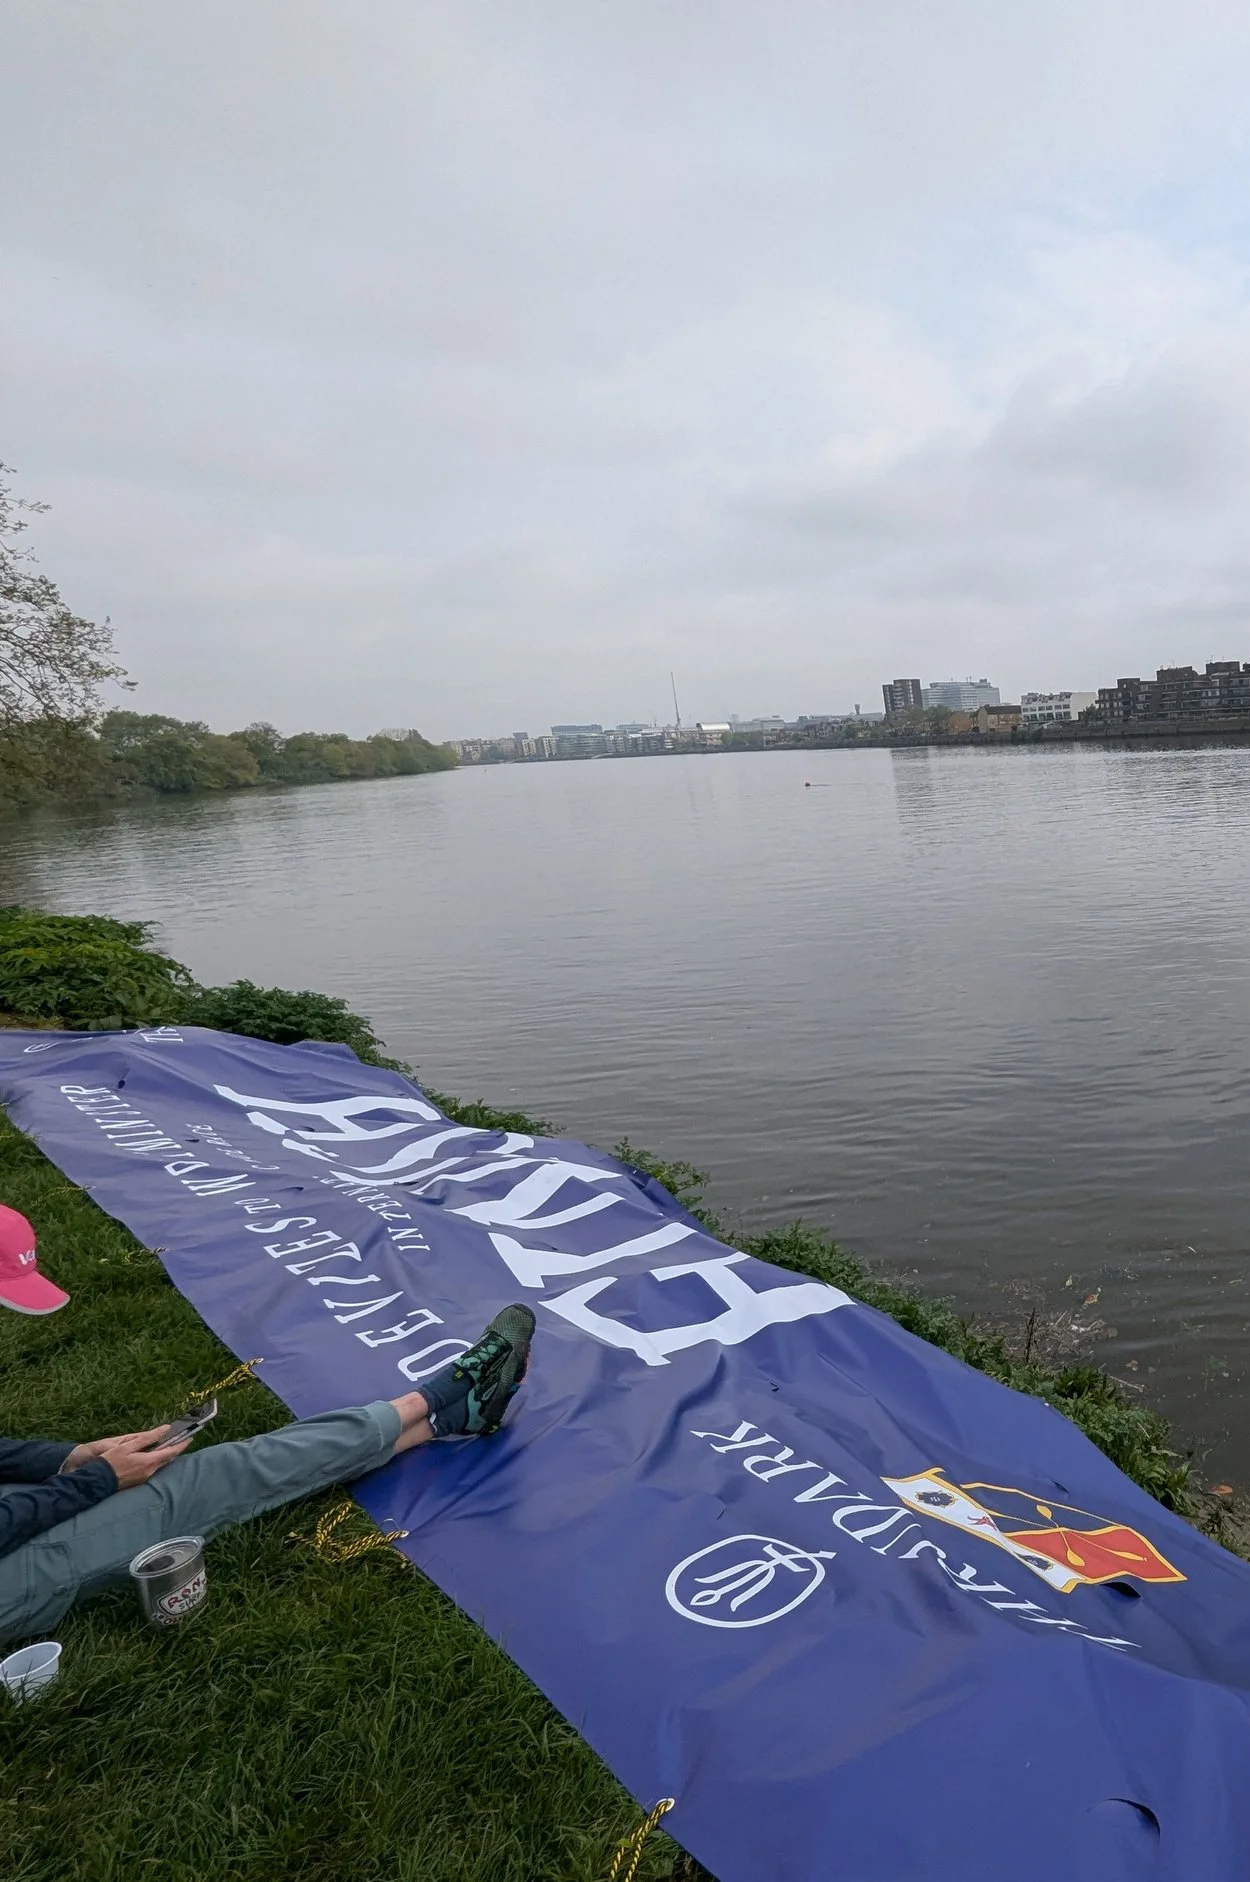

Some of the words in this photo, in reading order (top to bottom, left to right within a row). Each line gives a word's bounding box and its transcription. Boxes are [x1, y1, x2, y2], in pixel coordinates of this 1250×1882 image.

[60, 1084, 257, 1197] WMINSTER
[233, 1197, 282, 1215] TO
[213, 1083, 857, 1367] FINISH
[244, 1216, 476, 1382] DEVIZES
